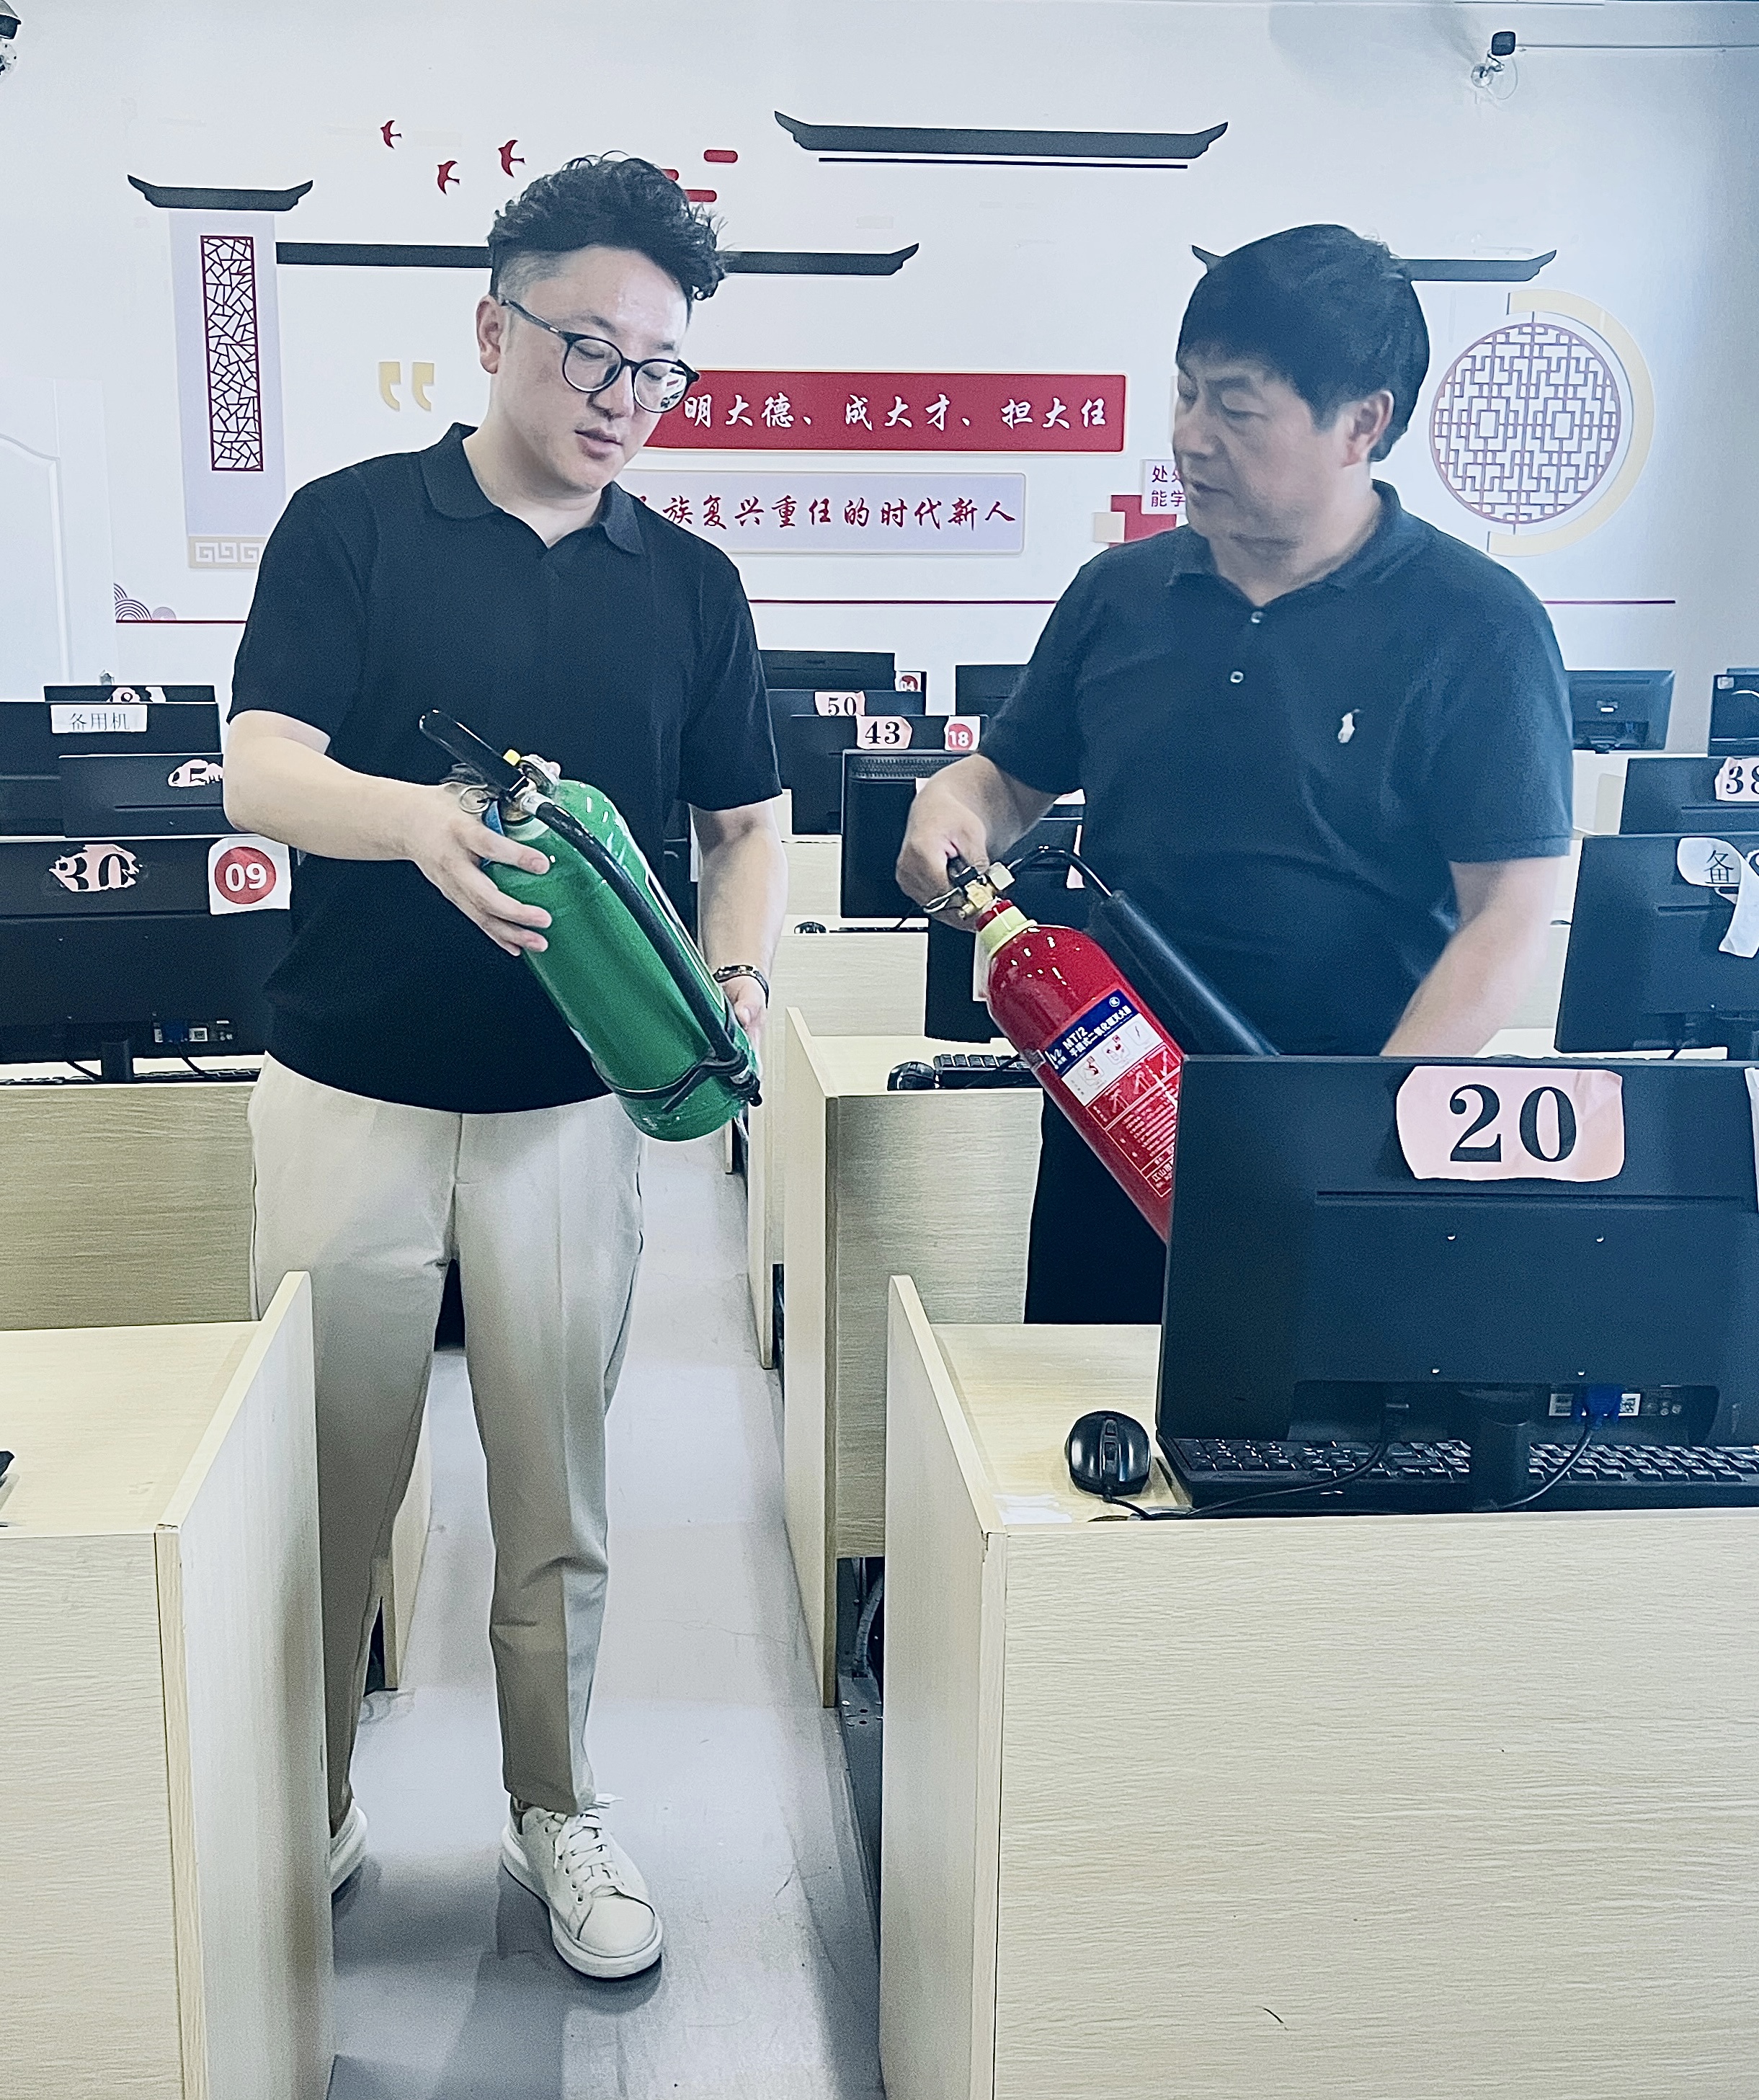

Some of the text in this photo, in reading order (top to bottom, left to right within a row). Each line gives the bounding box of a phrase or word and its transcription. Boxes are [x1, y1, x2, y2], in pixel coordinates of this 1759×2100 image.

[1151, 489, 1185, 507] 能学
[639, 494, 1015, 531] 族复兴重任的时代新人
[827, 696, 858, 716] 50
[69, 712, 130, 731] 备用机
[865, 721, 901, 744] 43
[949, 730, 969, 747] 18
[225, 862, 267, 893] 09
[1062, 1026, 1089, 1051] MT/2
[1449, 1084, 1577, 1162] 20
